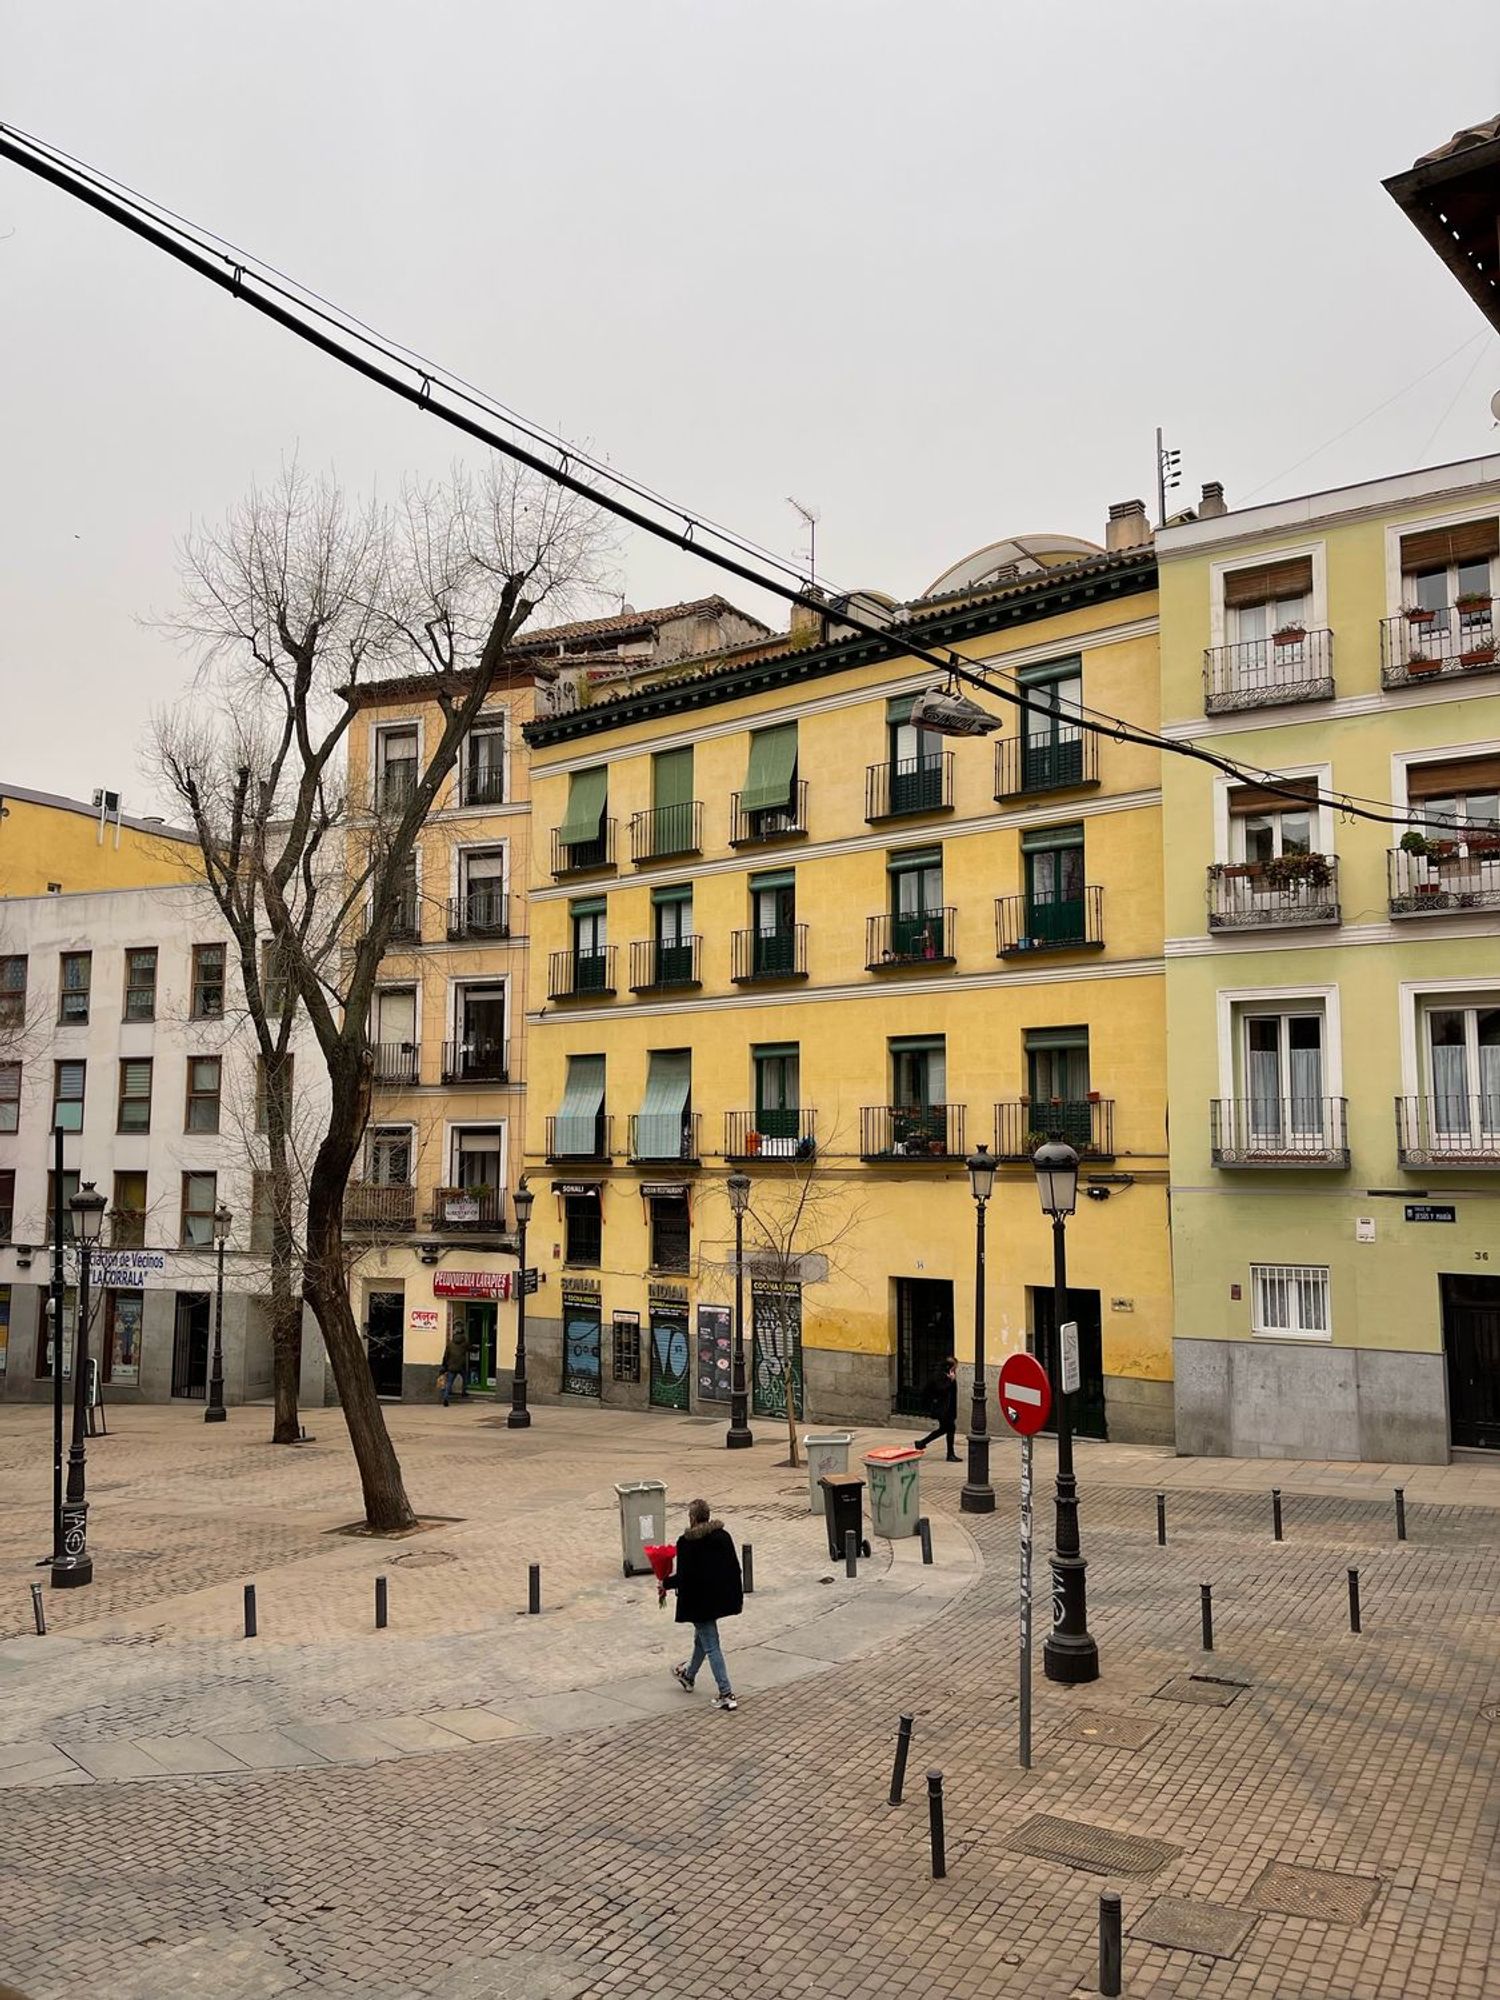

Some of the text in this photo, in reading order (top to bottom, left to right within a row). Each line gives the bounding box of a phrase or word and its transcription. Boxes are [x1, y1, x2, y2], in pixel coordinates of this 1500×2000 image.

[562, 1185, 584, 1193] SONALI
[120, 1252, 130, 1267] de
[132, 1253, 164, 1269] Vecinos
[1474, 1251, 1489, 1261] 36
[435, 1271, 475, 1290] PELUQUERIA
[561, 1278, 601, 1293] SONALI
[753, 1281, 778, 1291] COCNA
[901, 1472, 917, 1515] 7
[872, 1483, 886, 1524] 7
